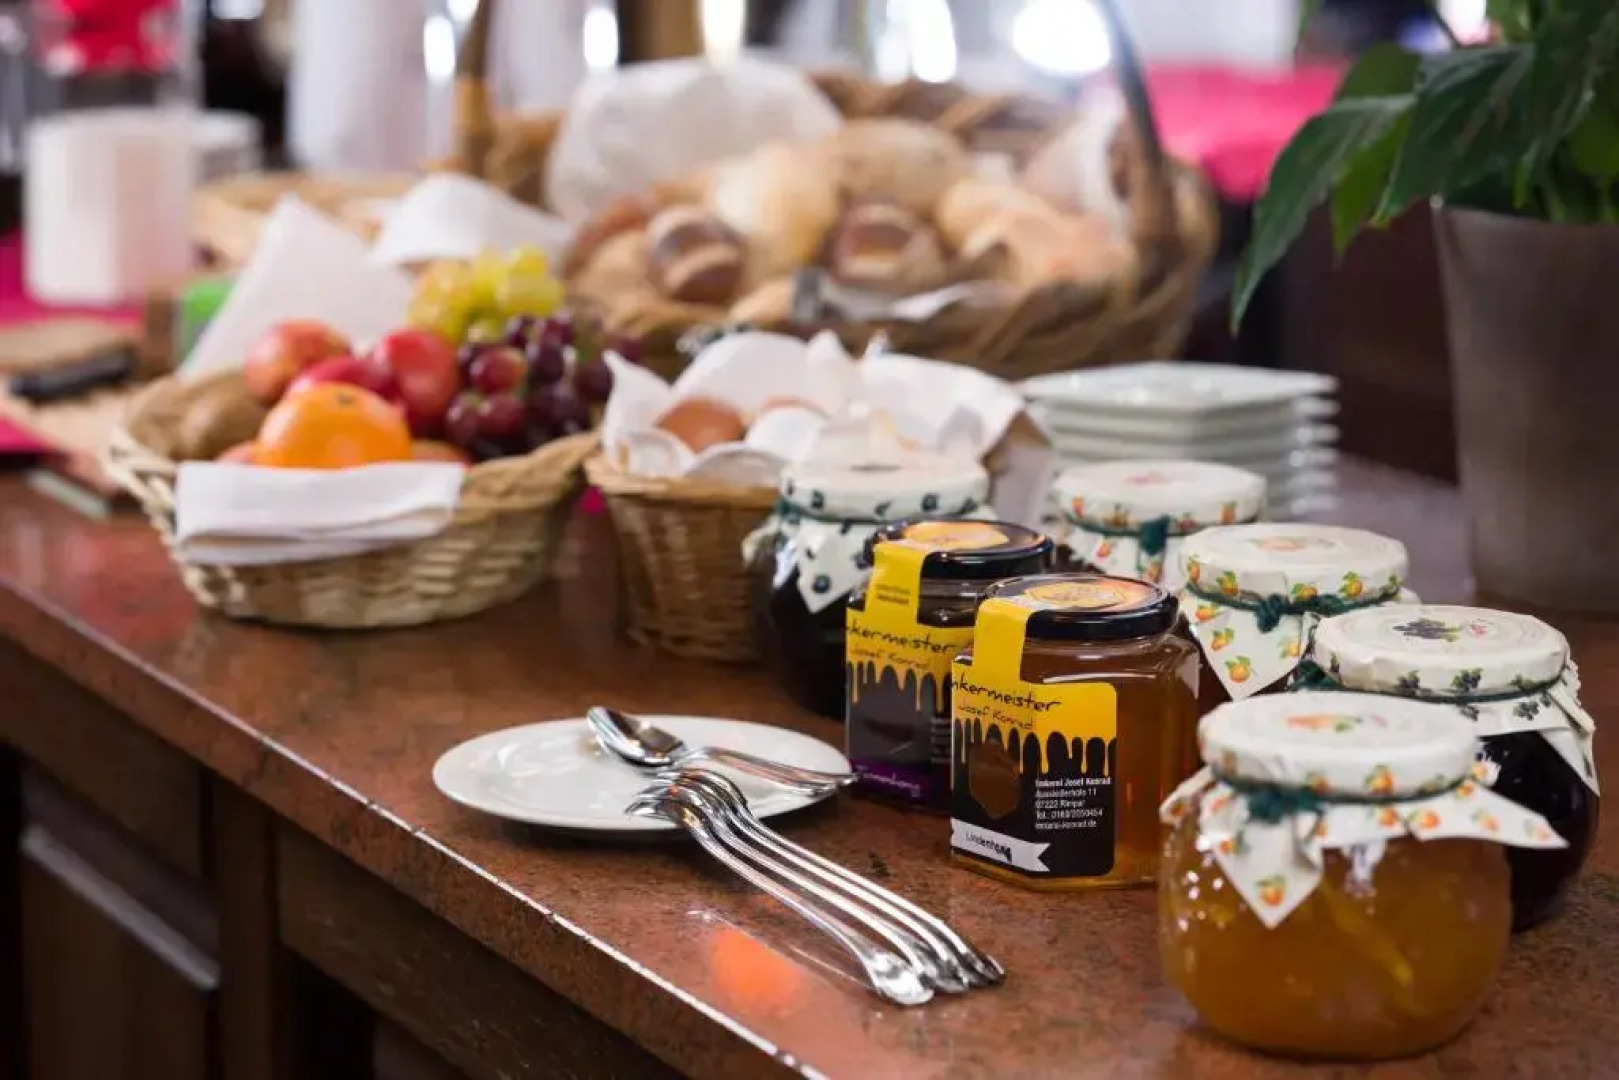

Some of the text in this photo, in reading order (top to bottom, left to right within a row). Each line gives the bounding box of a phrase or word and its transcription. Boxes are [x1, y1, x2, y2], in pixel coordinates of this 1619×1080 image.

[847, 618, 957, 654] kermeister
[957, 704, 1034, 730] Josef Konrad
